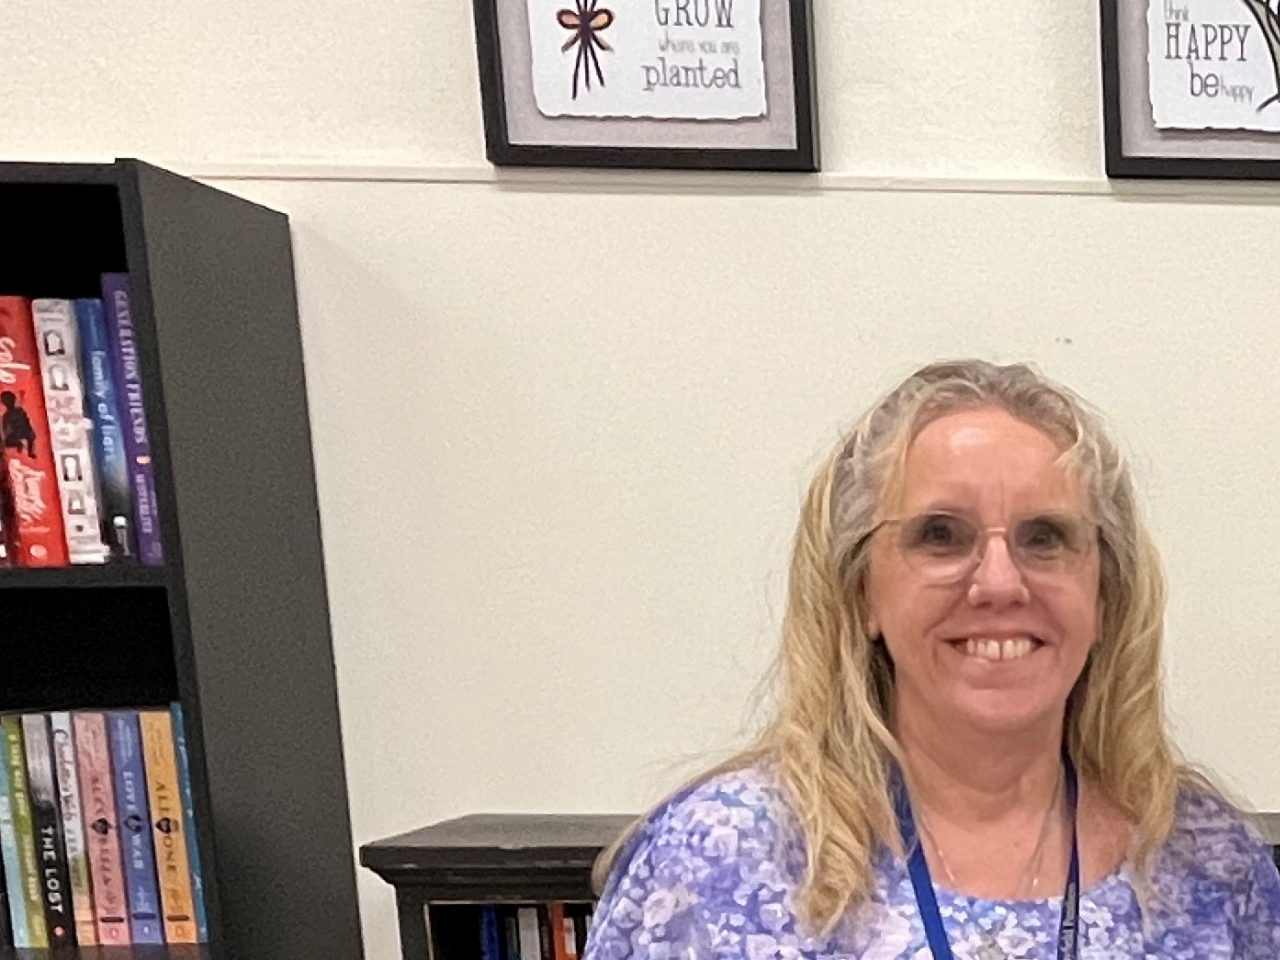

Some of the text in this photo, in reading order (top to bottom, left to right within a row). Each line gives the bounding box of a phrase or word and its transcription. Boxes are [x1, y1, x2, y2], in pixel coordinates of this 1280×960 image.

[655, 0, 734, 28] GROW
[1165, 23, 1251, 62] HAPPY
[642, 56, 741, 91] planted
[1187, 61, 1219, 98] be
[90, 350, 107, 398] family
[113, 290, 149, 444] GENERATION FRIENDS
[97, 402, 114, 424] of
[41, 826, 64, 914] THE LOST
[163, 835, 178, 873] ONE
